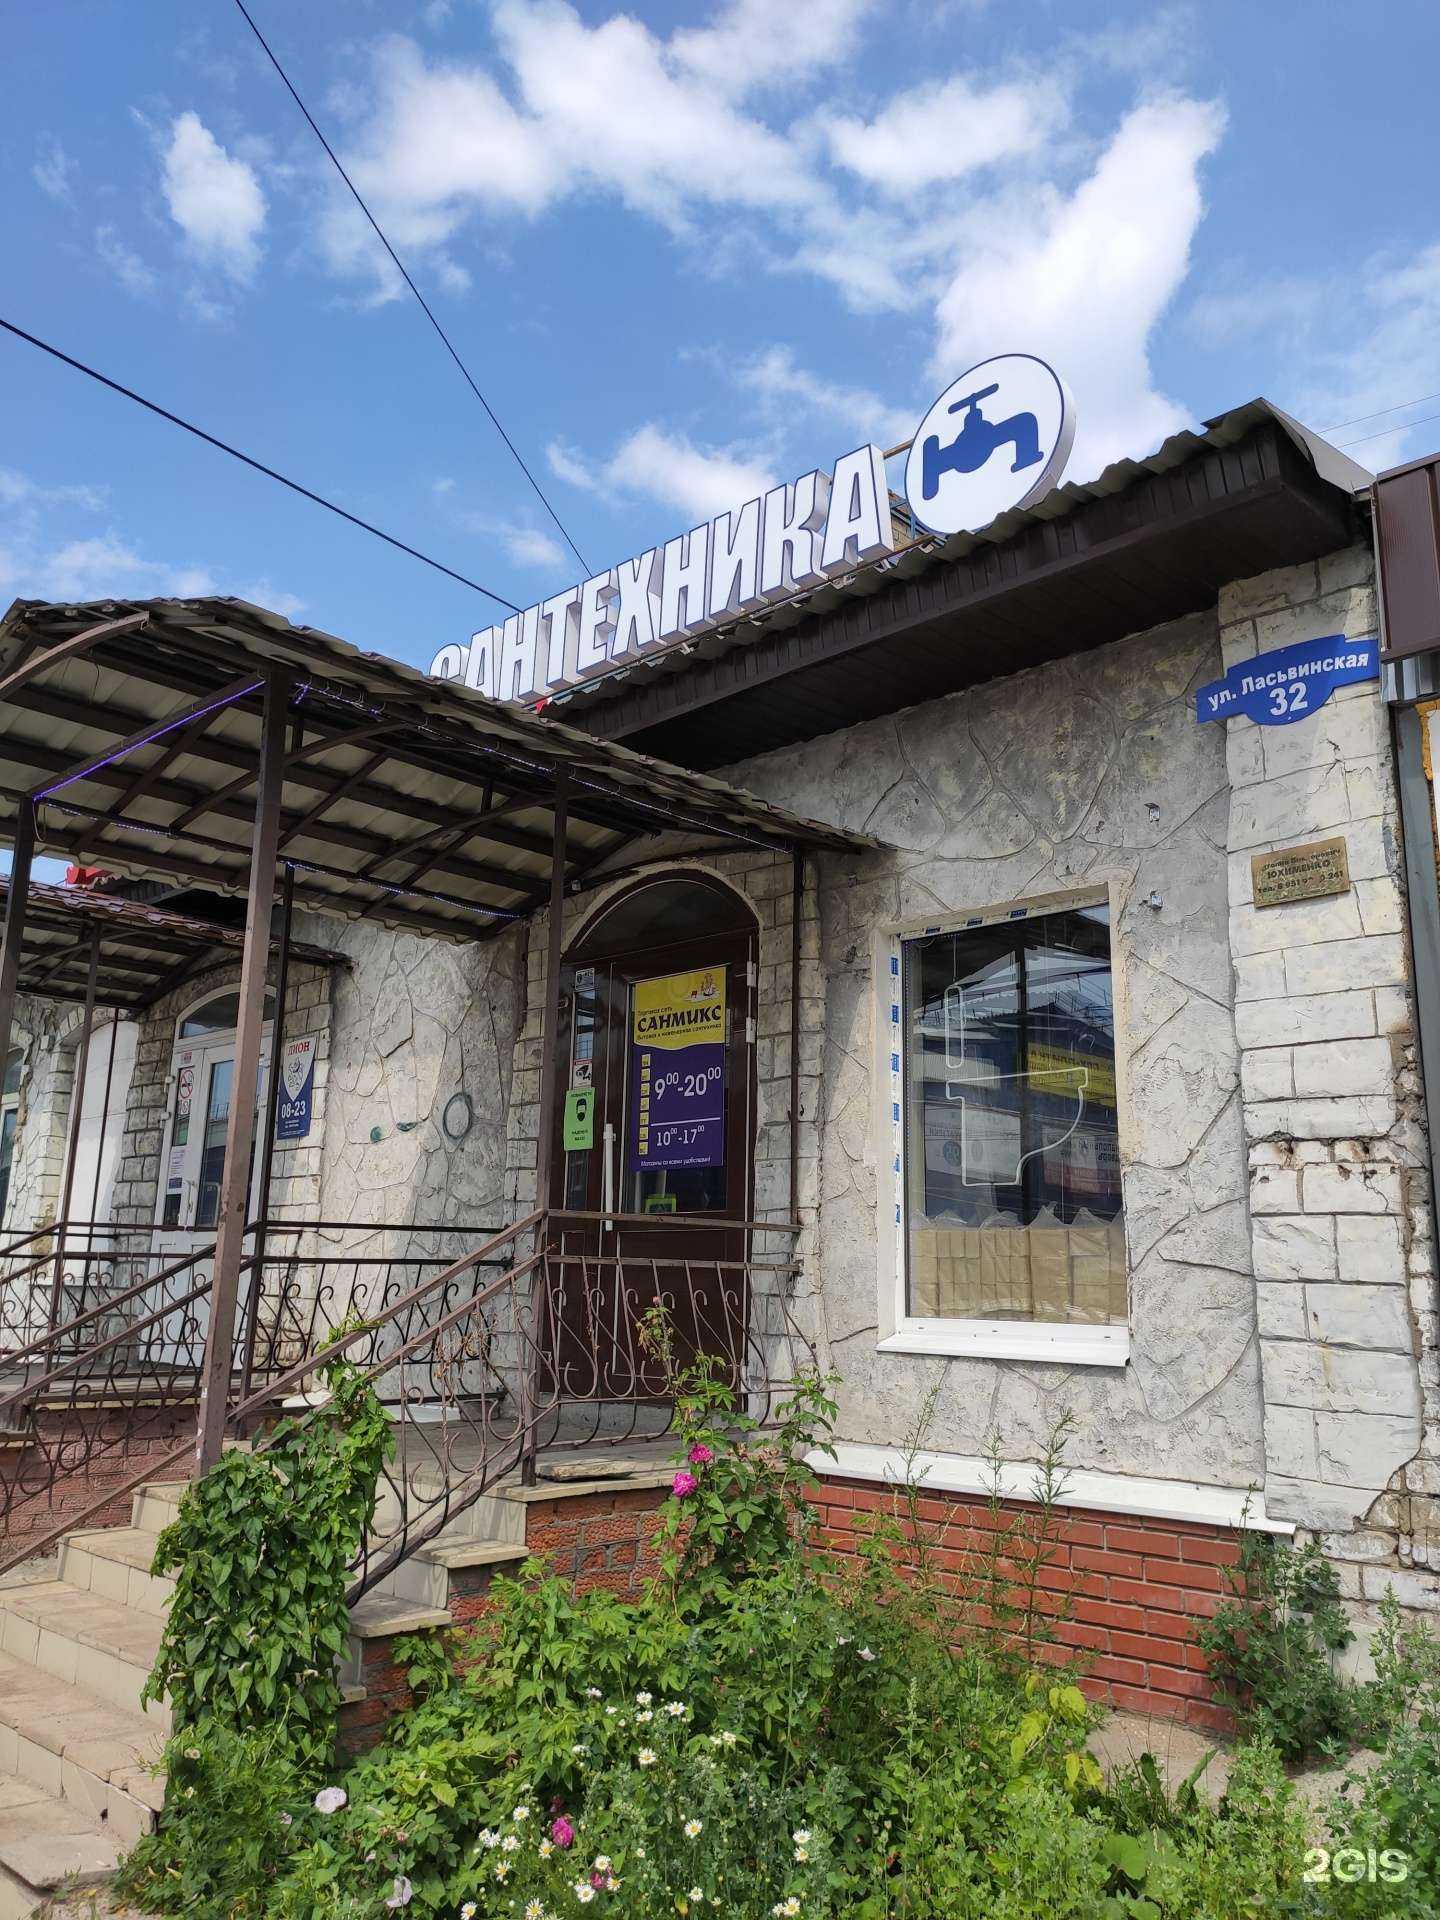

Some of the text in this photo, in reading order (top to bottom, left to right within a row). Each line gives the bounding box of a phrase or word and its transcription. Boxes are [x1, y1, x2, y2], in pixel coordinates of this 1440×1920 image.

[1207, 653, 1369, 711] ул. Ласьвинская
[1269, 682, 1308, 716] 32
[637, 1004, 722, 1033] САНМИКС
[281, 1101, 306, 1119] 08-23
